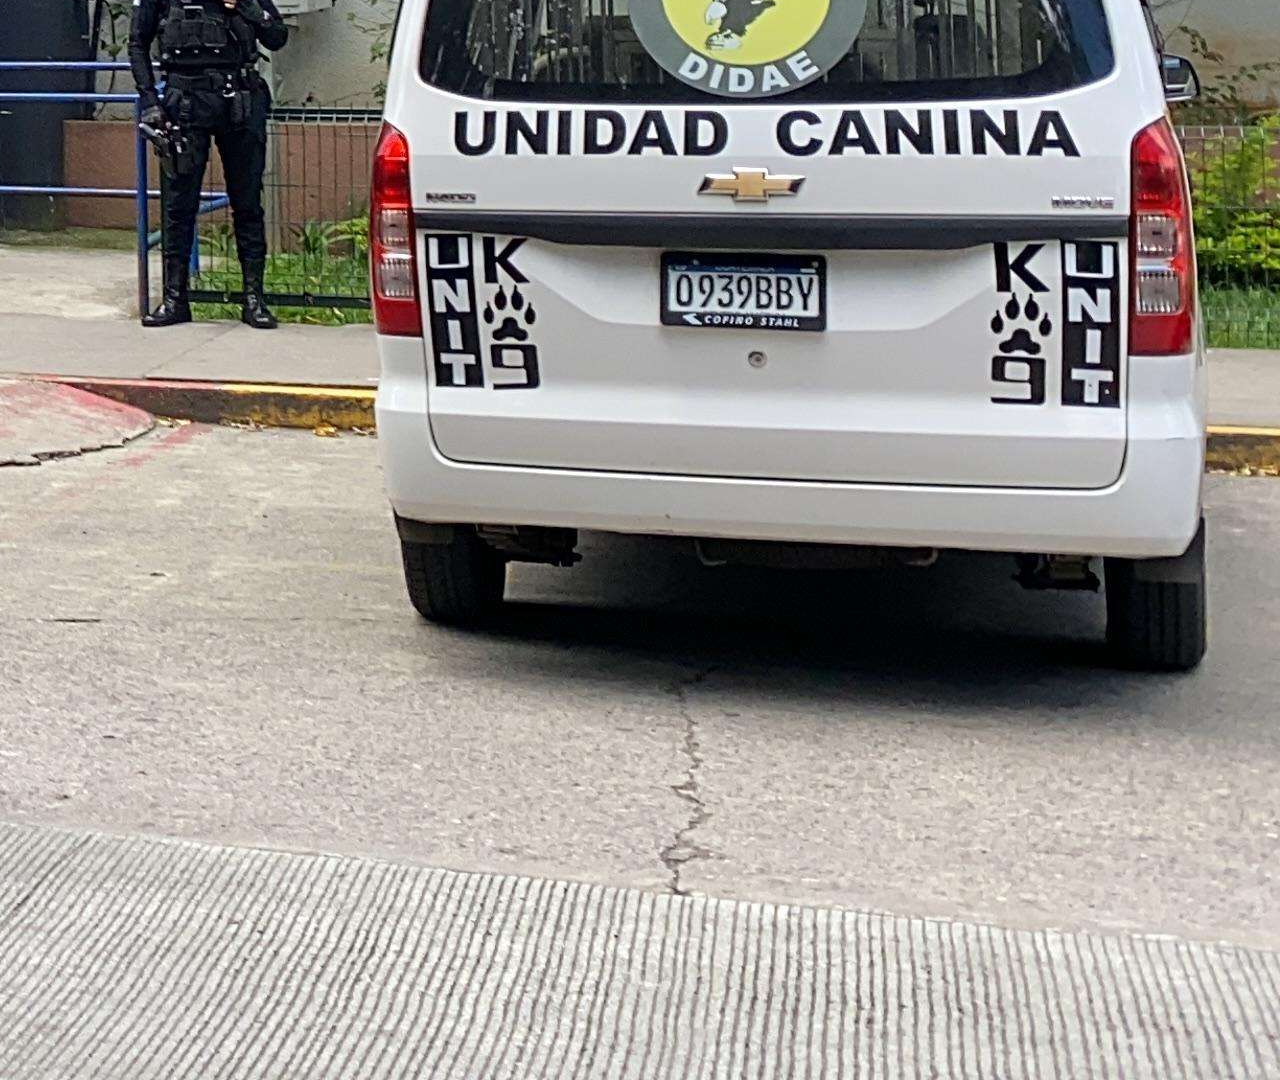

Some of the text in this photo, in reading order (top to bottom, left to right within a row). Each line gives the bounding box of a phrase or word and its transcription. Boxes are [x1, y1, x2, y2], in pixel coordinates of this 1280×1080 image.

[678, 50, 821, 93] DIDAE
[453, 110, 1081, 157] UNIDAD CANINA
[427, 236, 476, 386] UNIT
[676, 274, 814, 311] 0939BBY
[760, 317, 800, 328] STAHL
[1064, 242, 1114, 404] UNIT
